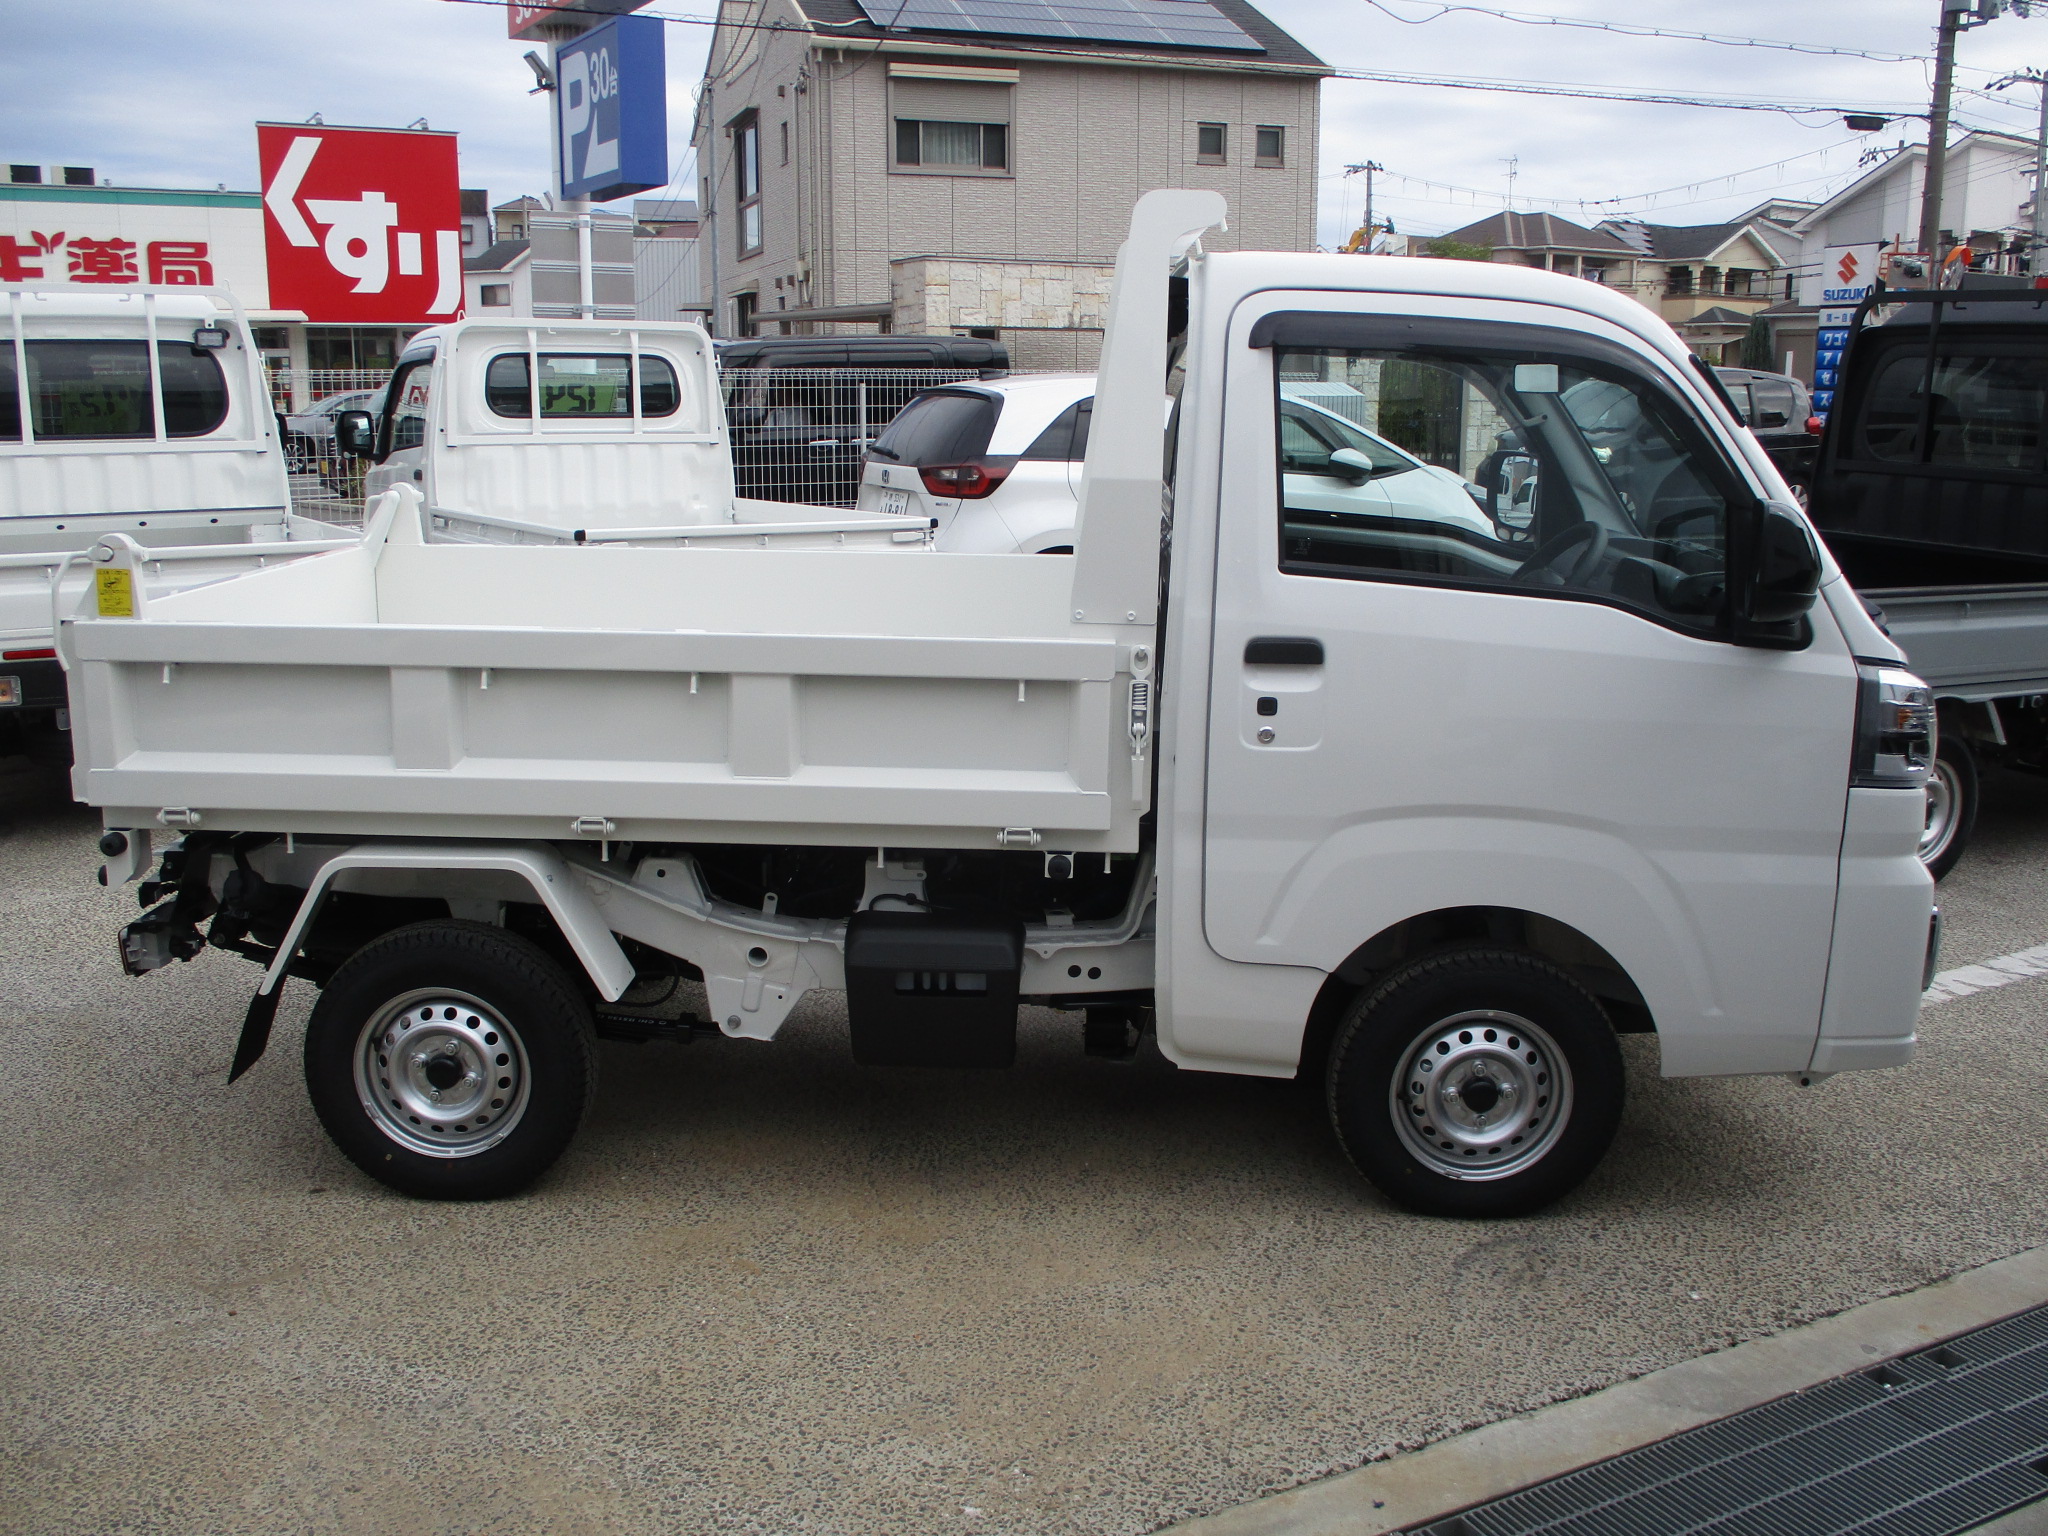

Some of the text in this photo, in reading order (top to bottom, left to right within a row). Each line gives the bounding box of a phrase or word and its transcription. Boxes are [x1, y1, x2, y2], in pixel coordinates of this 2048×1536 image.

[264, 136, 466, 315] くすり
[1823, 288, 1868, 301] SUZUK
[1821, 371, 1838, 385] セ
